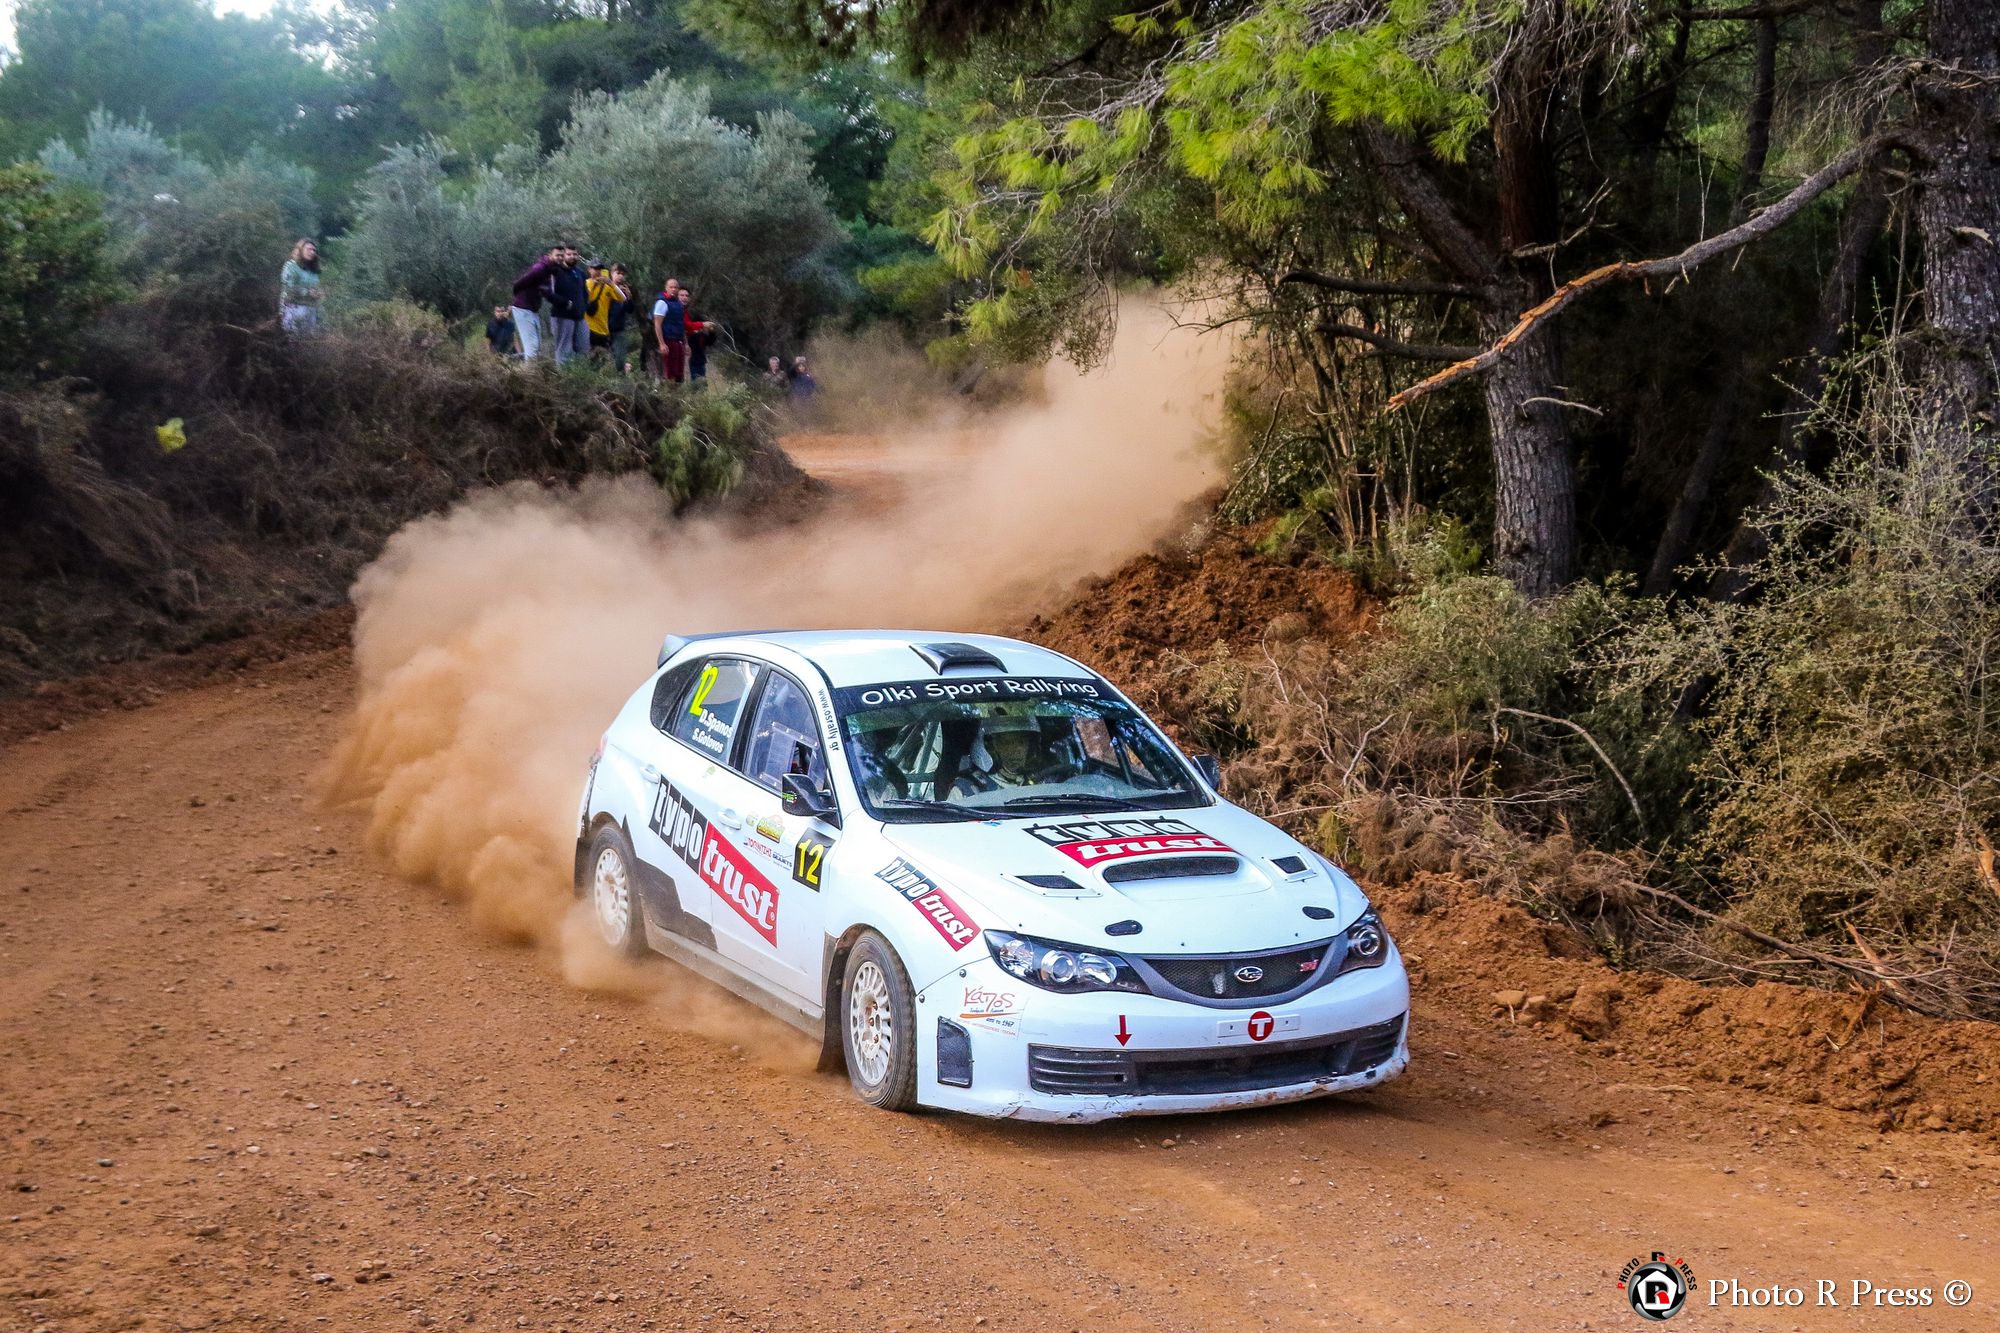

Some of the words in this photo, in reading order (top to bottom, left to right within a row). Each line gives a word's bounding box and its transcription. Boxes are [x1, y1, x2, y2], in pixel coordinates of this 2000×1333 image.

[690, 665, 719, 716] 12
[861, 685, 917, 705] Olki
[925, 681, 999, 700] Sport
[1003, 679, 1099, 697] Rallying
[699, 708, 734, 739] D.Spanos
[654, 783, 703, 860] typo
[1034, 821, 1199, 842] typo
[798, 838, 824, 885] 12
[1076, 837, 1227, 860] trust
[703, 838, 774, 930] trust
[919, 894, 974, 945] trust
[1250, 1017, 1272, 1037] T
